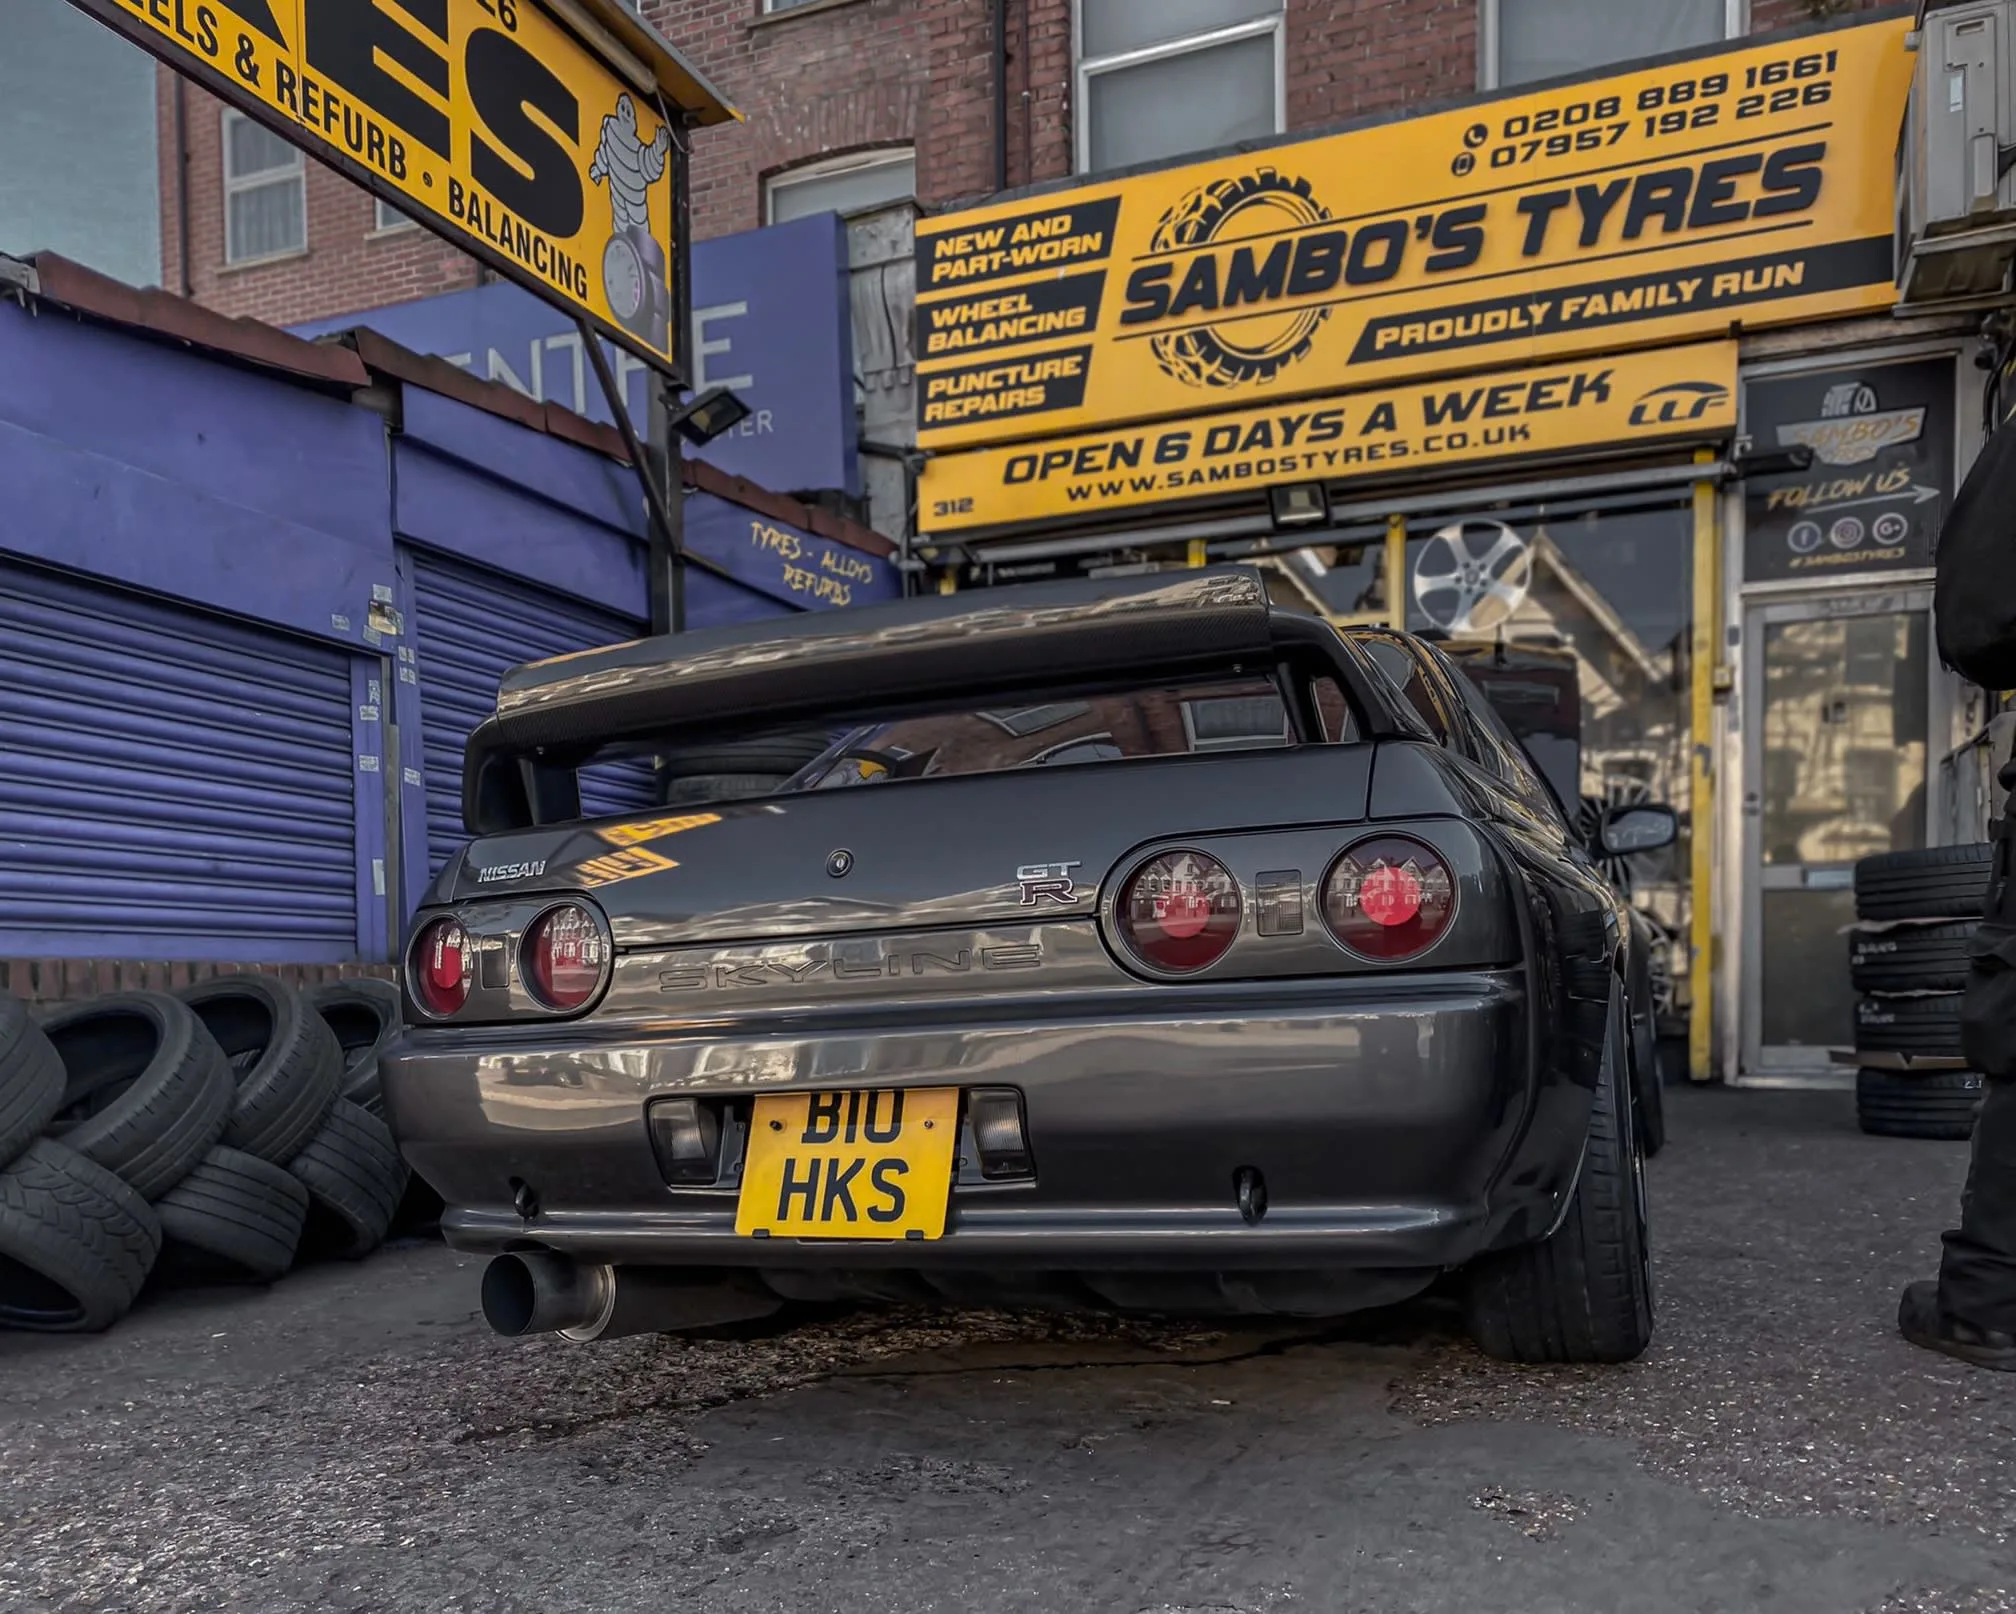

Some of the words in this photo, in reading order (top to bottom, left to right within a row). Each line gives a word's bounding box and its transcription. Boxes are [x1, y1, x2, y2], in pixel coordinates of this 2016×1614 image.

[1503, 96, 1621, 139] 0208
[1637, 73, 1729, 112] 889
[1745, 49, 1838, 89] 1661
[1490, 121, 1630, 168] 07957
[1645, 103, 1720, 138] 192
[1735, 80, 1832, 120] 226
[234, 33, 260, 89] &
[276, 58, 407, 182] REFURB
[449, 176, 588, 302] BALANCING
[932, 232, 1103, 283] PART-WORN
[935, 227, 1005, 259] NEW
[1010, 214, 1072, 244] AND
[1119, 203, 1488, 327] SAMBO'S
[1516, 142, 1828, 259] TYRES
[927, 306, 1086, 353] BALANCING
[931, 293, 1032, 329] WHEEL
[1374, 302, 1551, 350] PROUDLY
[1560, 278, 1702, 321] FAMILY
[1712, 262, 1804, 298] RUN
[927, 355, 1083, 399] PUNCTURE
[924, 385, 1046, 423] REPAIRS
[1003, 437, 1144, 485] OPEN
[1154, 432, 1192, 464] 6
[1202, 408, 1345, 458] DAYS
[1360, 402, 1397, 435] A
[1422, 369, 1614, 427] WEEK
[1066, 423, 1531, 501] WWW.SAMBOSTYRES.CO.UK
[933, 497, 974, 517] 312
[1767, 472, 1872, 511] FOLLOW
[1876, 467, 1911, 493] US
[752, 521, 801, 560] TYRES
[821, 550, 873, 584] ALLOYS
[783, 563, 851, 606] REFURBS
[477, 860, 546, 883] NISSAN
[1016, 861, 1081, 880] GT
[1020, 878, 1078, 906] R
[659, 943, 1041, 993] SKYLINE
[776, 1158, 909, 1222] HKS
